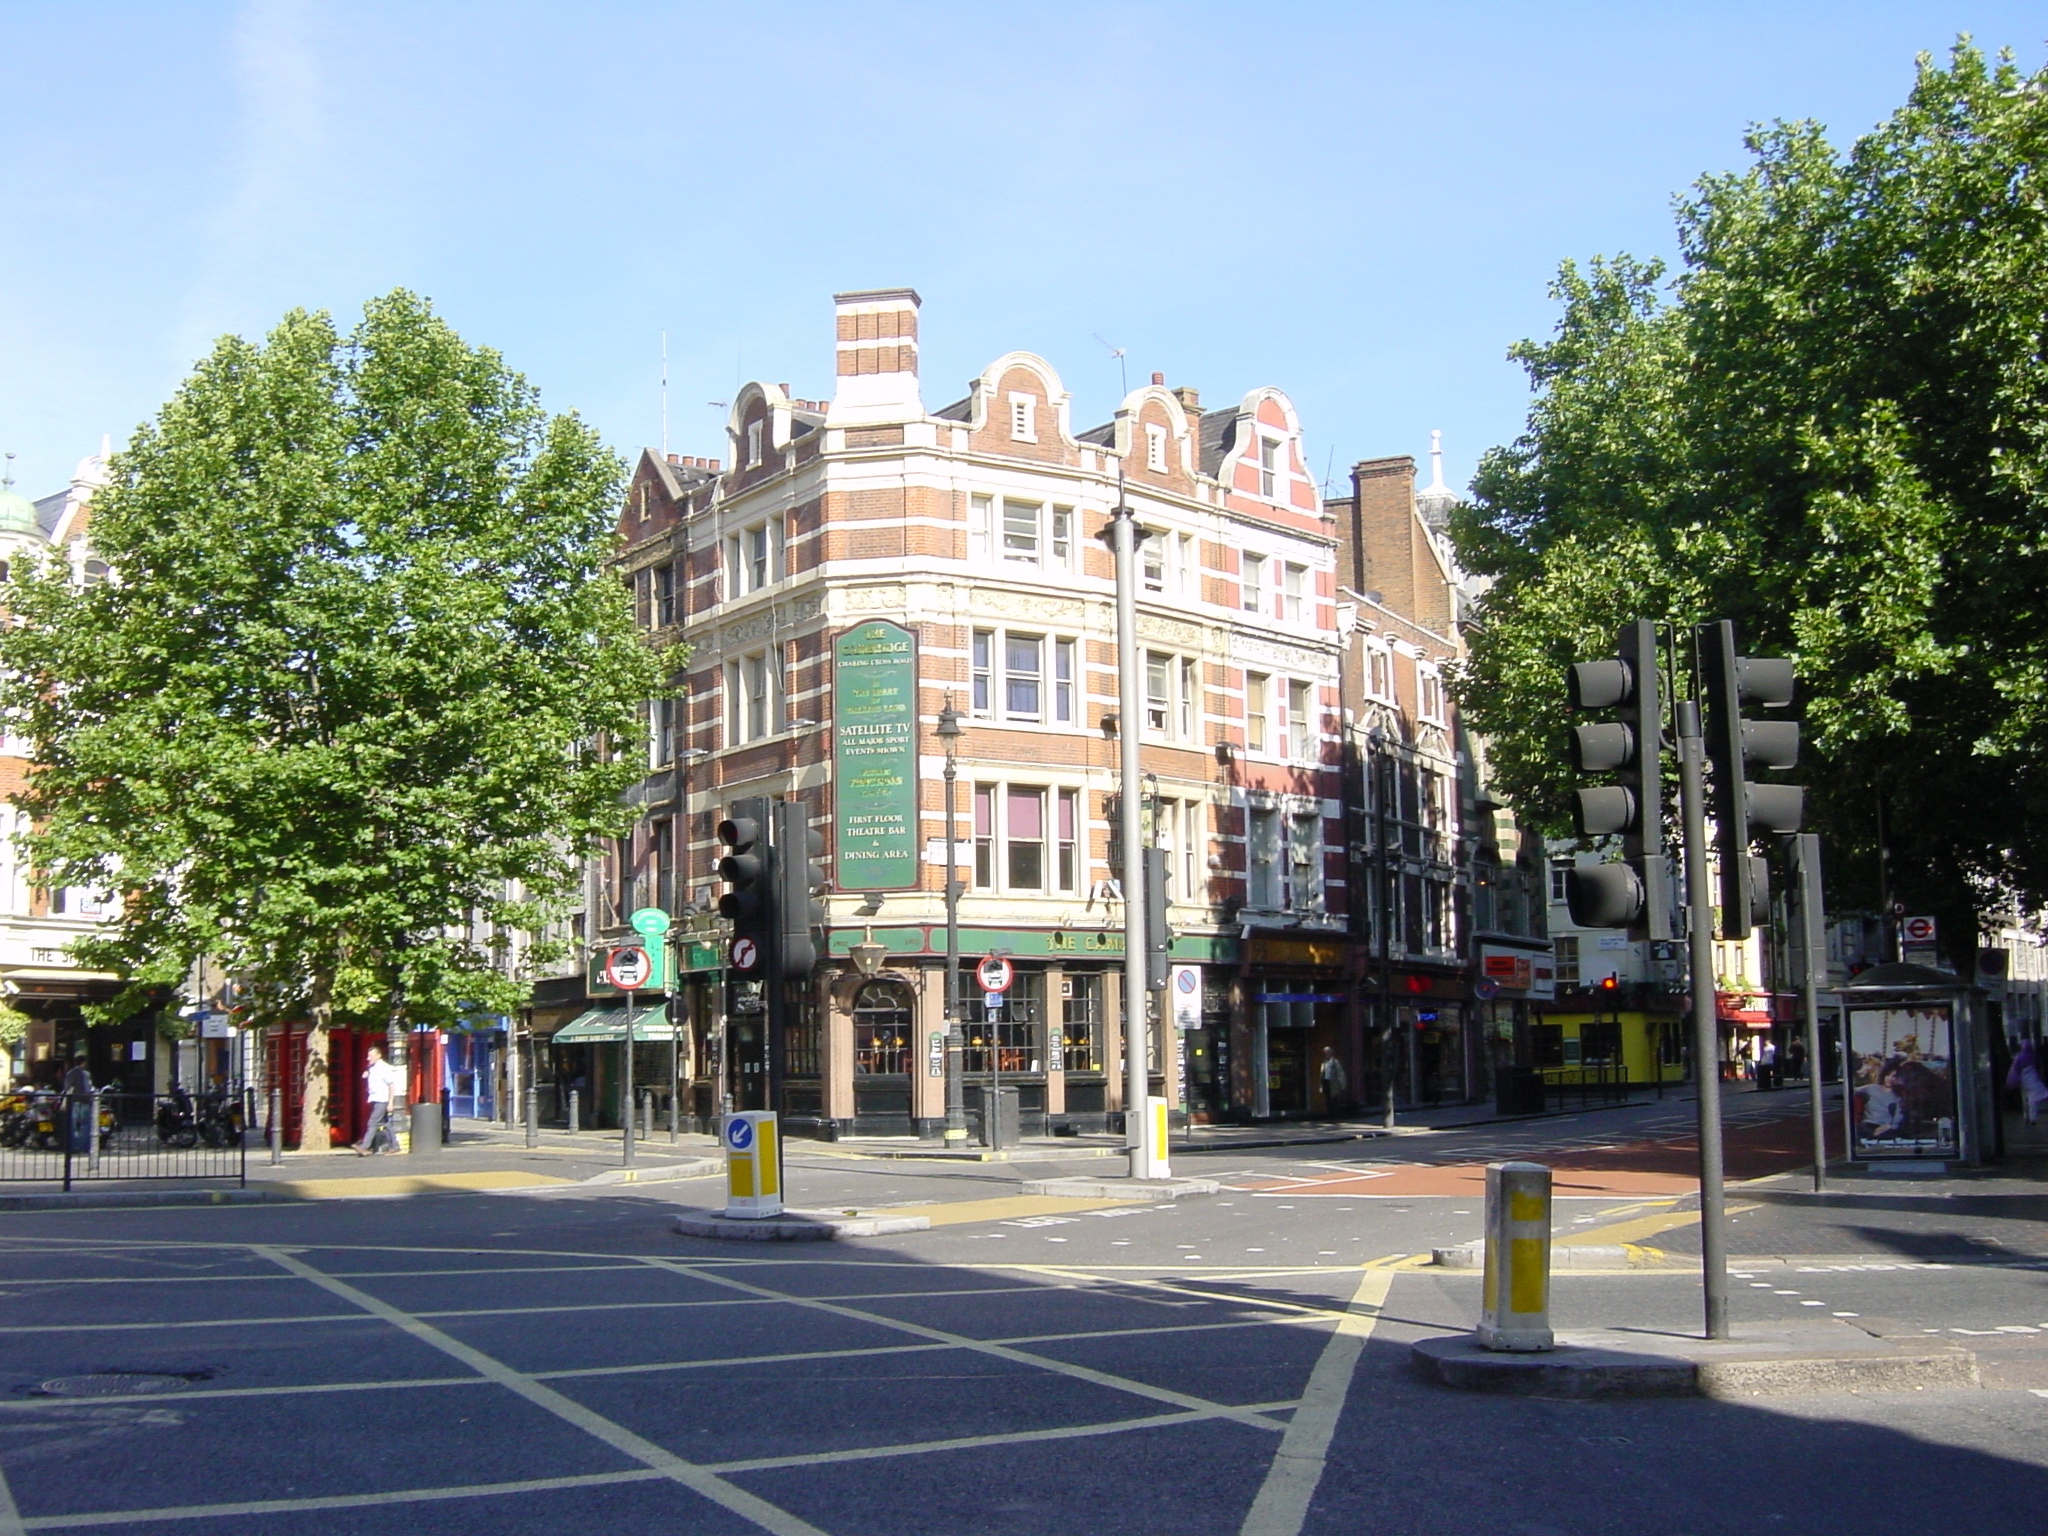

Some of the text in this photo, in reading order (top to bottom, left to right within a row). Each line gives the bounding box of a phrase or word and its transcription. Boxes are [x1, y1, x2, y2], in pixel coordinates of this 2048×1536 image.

[840, 722, 911, 736] SATELLITE TV
[858, 737, 884, 745] MAJOR
[886, 736, 909, 744] SPORT
[845, 746, 906, 756] EVENTS SHOWN
[849, 814, 903, 824] FIRST FLOOR
[846, 826, 906, 837] THEATRE BAR
[844, 850, 909, 860] DINING AREA
[1046, 936, 1076, 951] THE
[31, 948, 54, 963] THE
